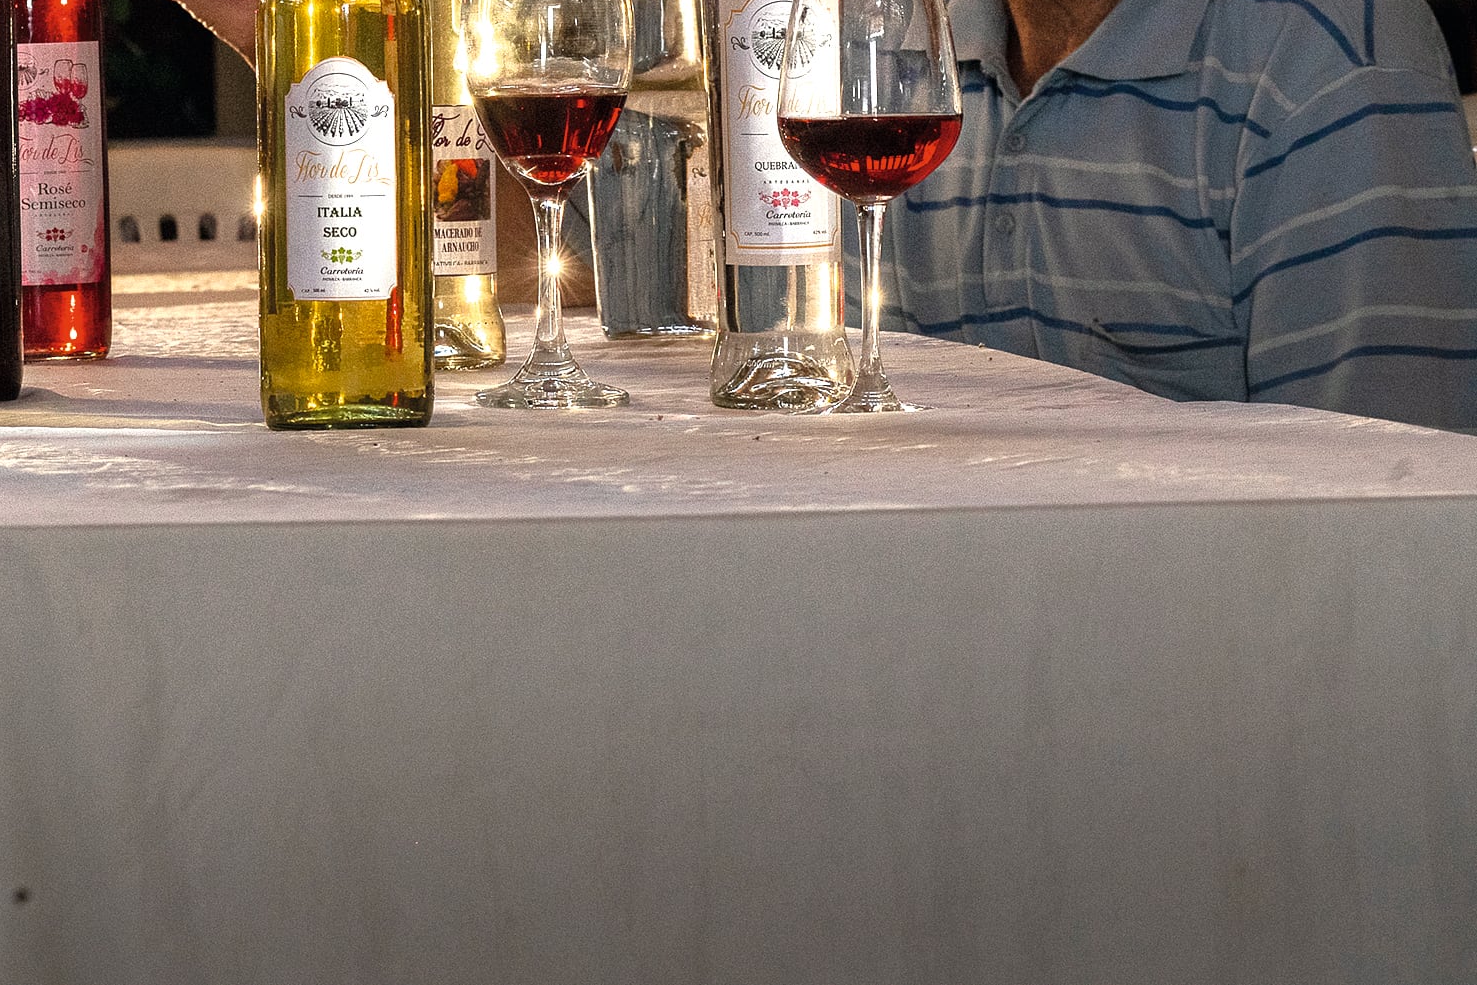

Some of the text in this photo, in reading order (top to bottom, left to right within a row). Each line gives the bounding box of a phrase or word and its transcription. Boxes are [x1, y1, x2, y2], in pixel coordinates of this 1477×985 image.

[737, 85, 774, 120] Flor
[456, 119, 473, 146] de
[41, 135, 58, 160] de
[56, 134, 94, 164] Lis
[293, 150, 327, 183] Flor
[329, 149, 348, 178] de
[754, 161, 798, 171] QUEBRA
[38, 182, 73, 195] Rosé
[21, 197, 86, 210] Semiseco
[317, 207, 362, 217] ITALIA
[323, 227, 357, 237] SECO
[434, 228, 473, 238] MACERADO
[442, 242, 480, 252] ARNAUCHO
